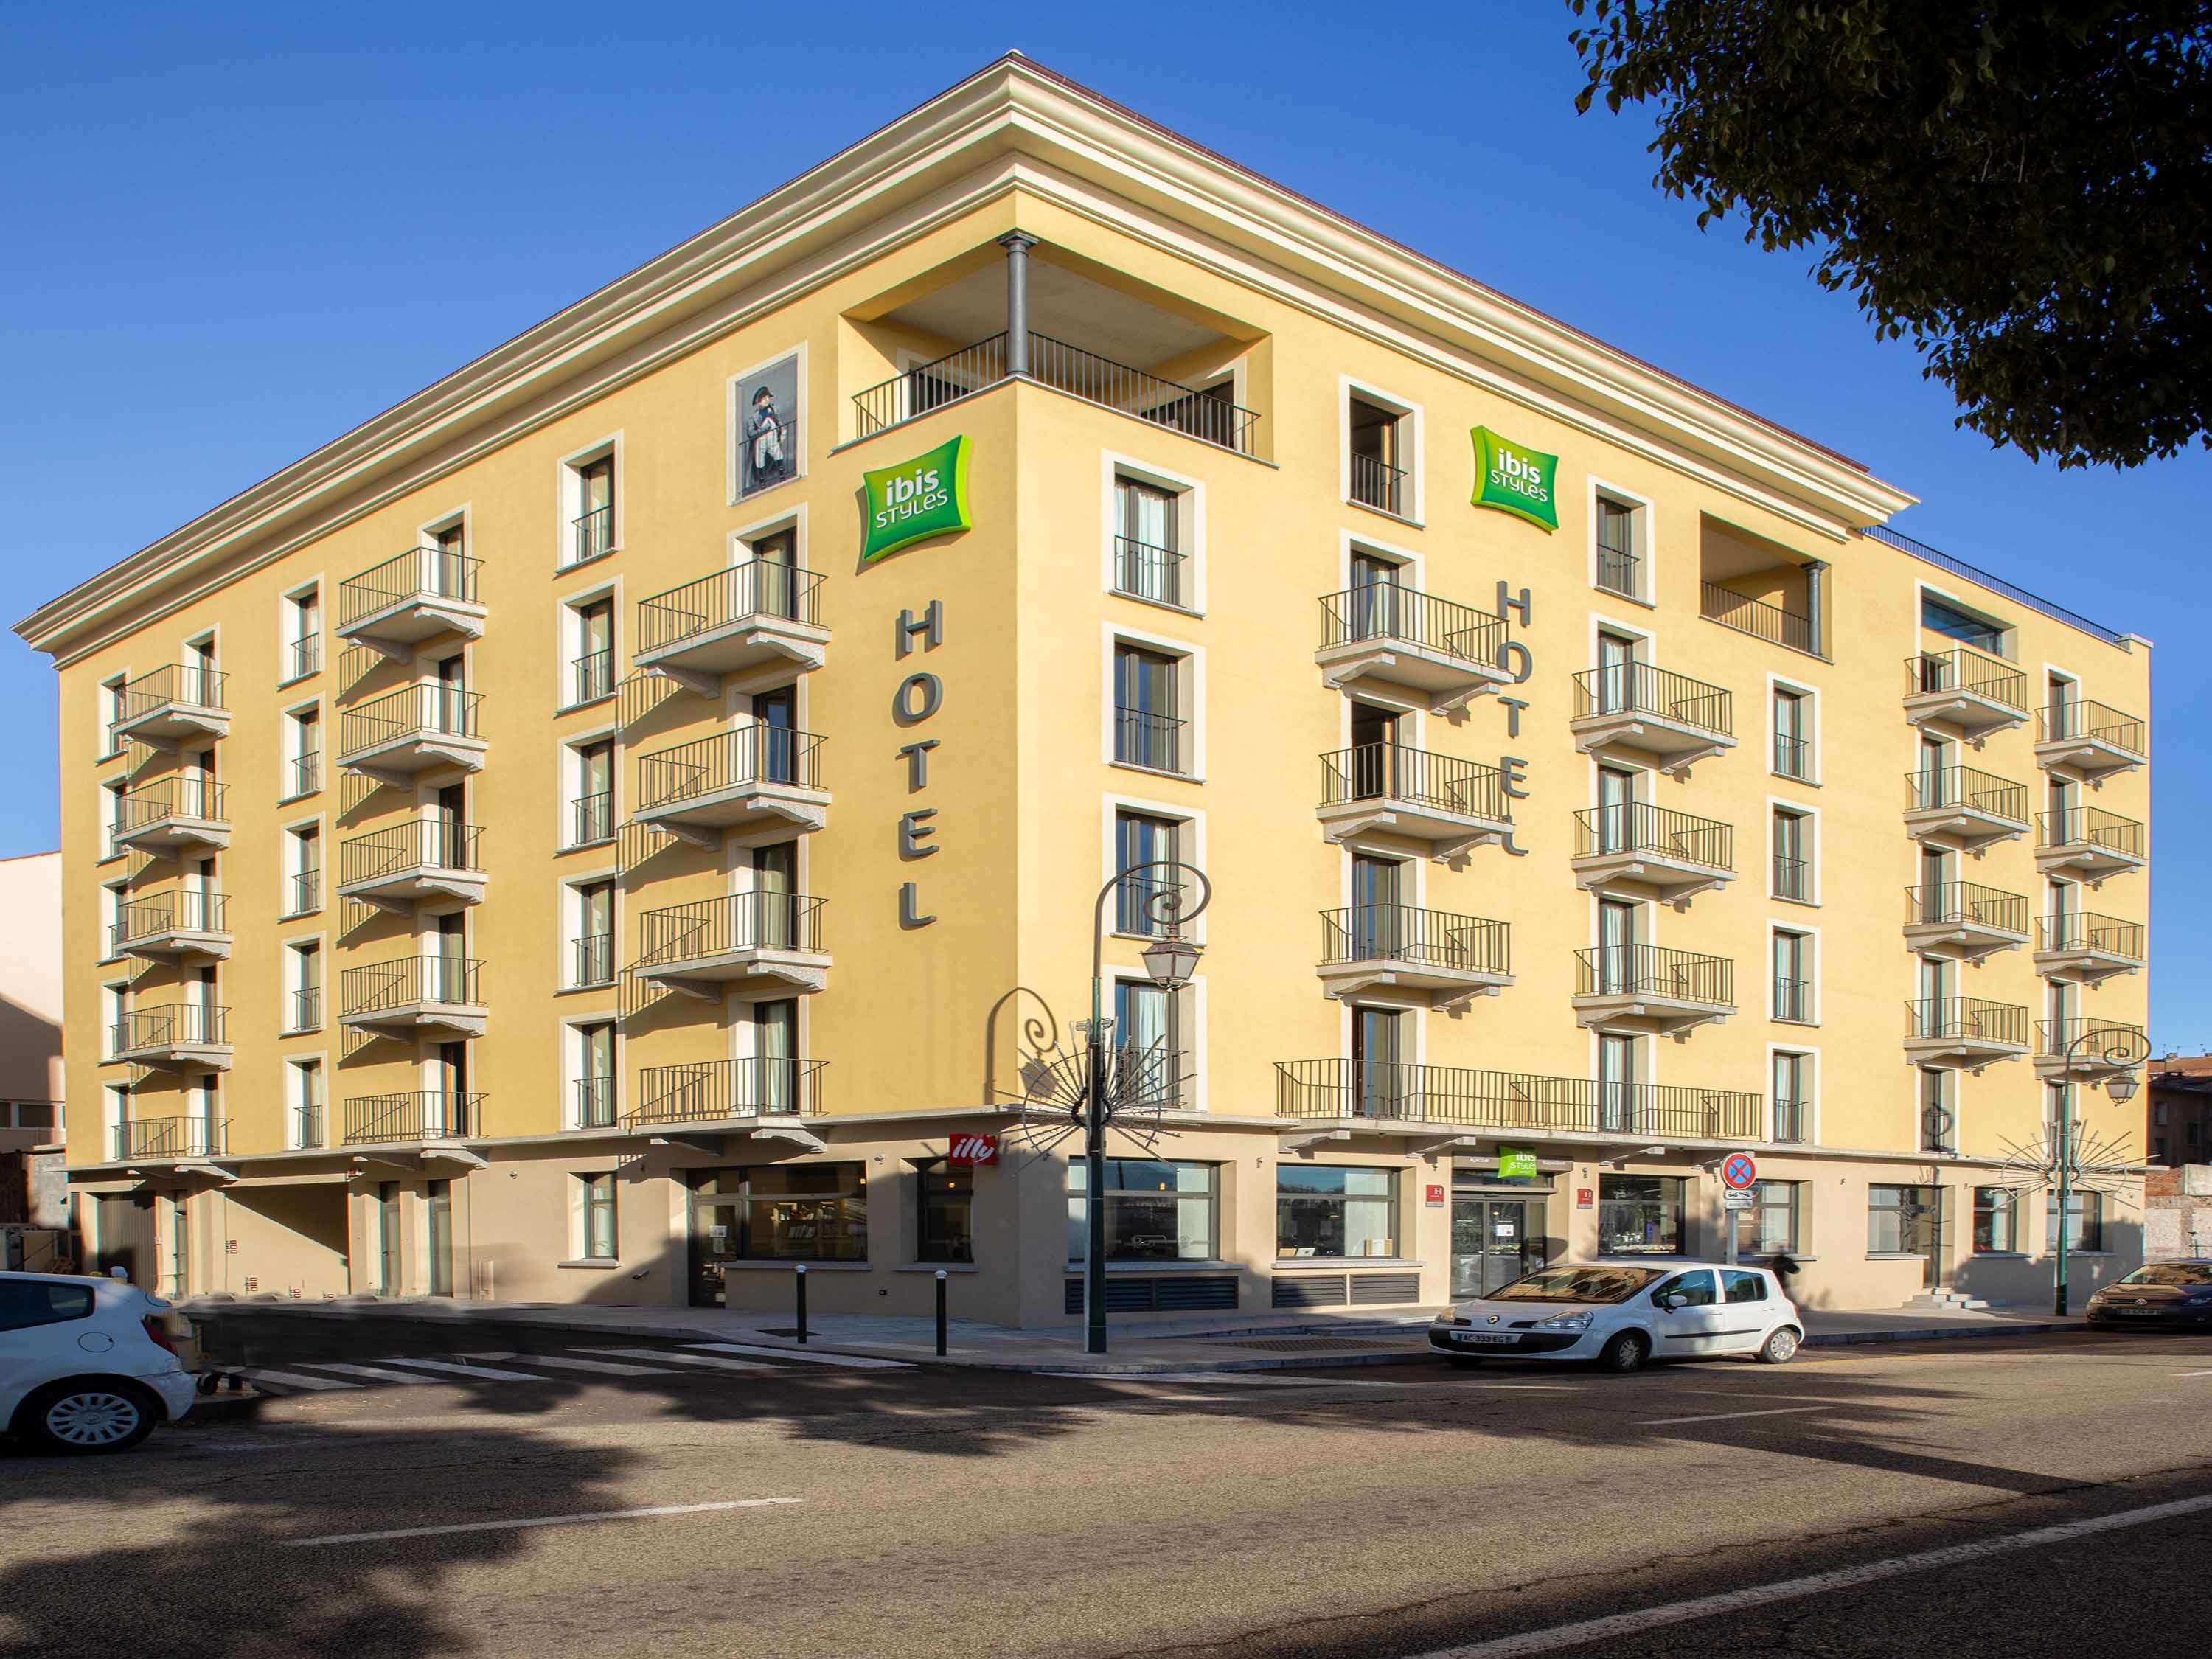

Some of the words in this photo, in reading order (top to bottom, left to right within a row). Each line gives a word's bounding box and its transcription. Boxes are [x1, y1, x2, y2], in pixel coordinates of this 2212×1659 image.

[1498, 448, 1541, 484] ibis
[886, 468, 939, 508] ibis
[1496, 580, 1532, 857] HOTEL
[896, 599, 943, 929] HOTEL
[952, 1138, 995, 1163] illy
